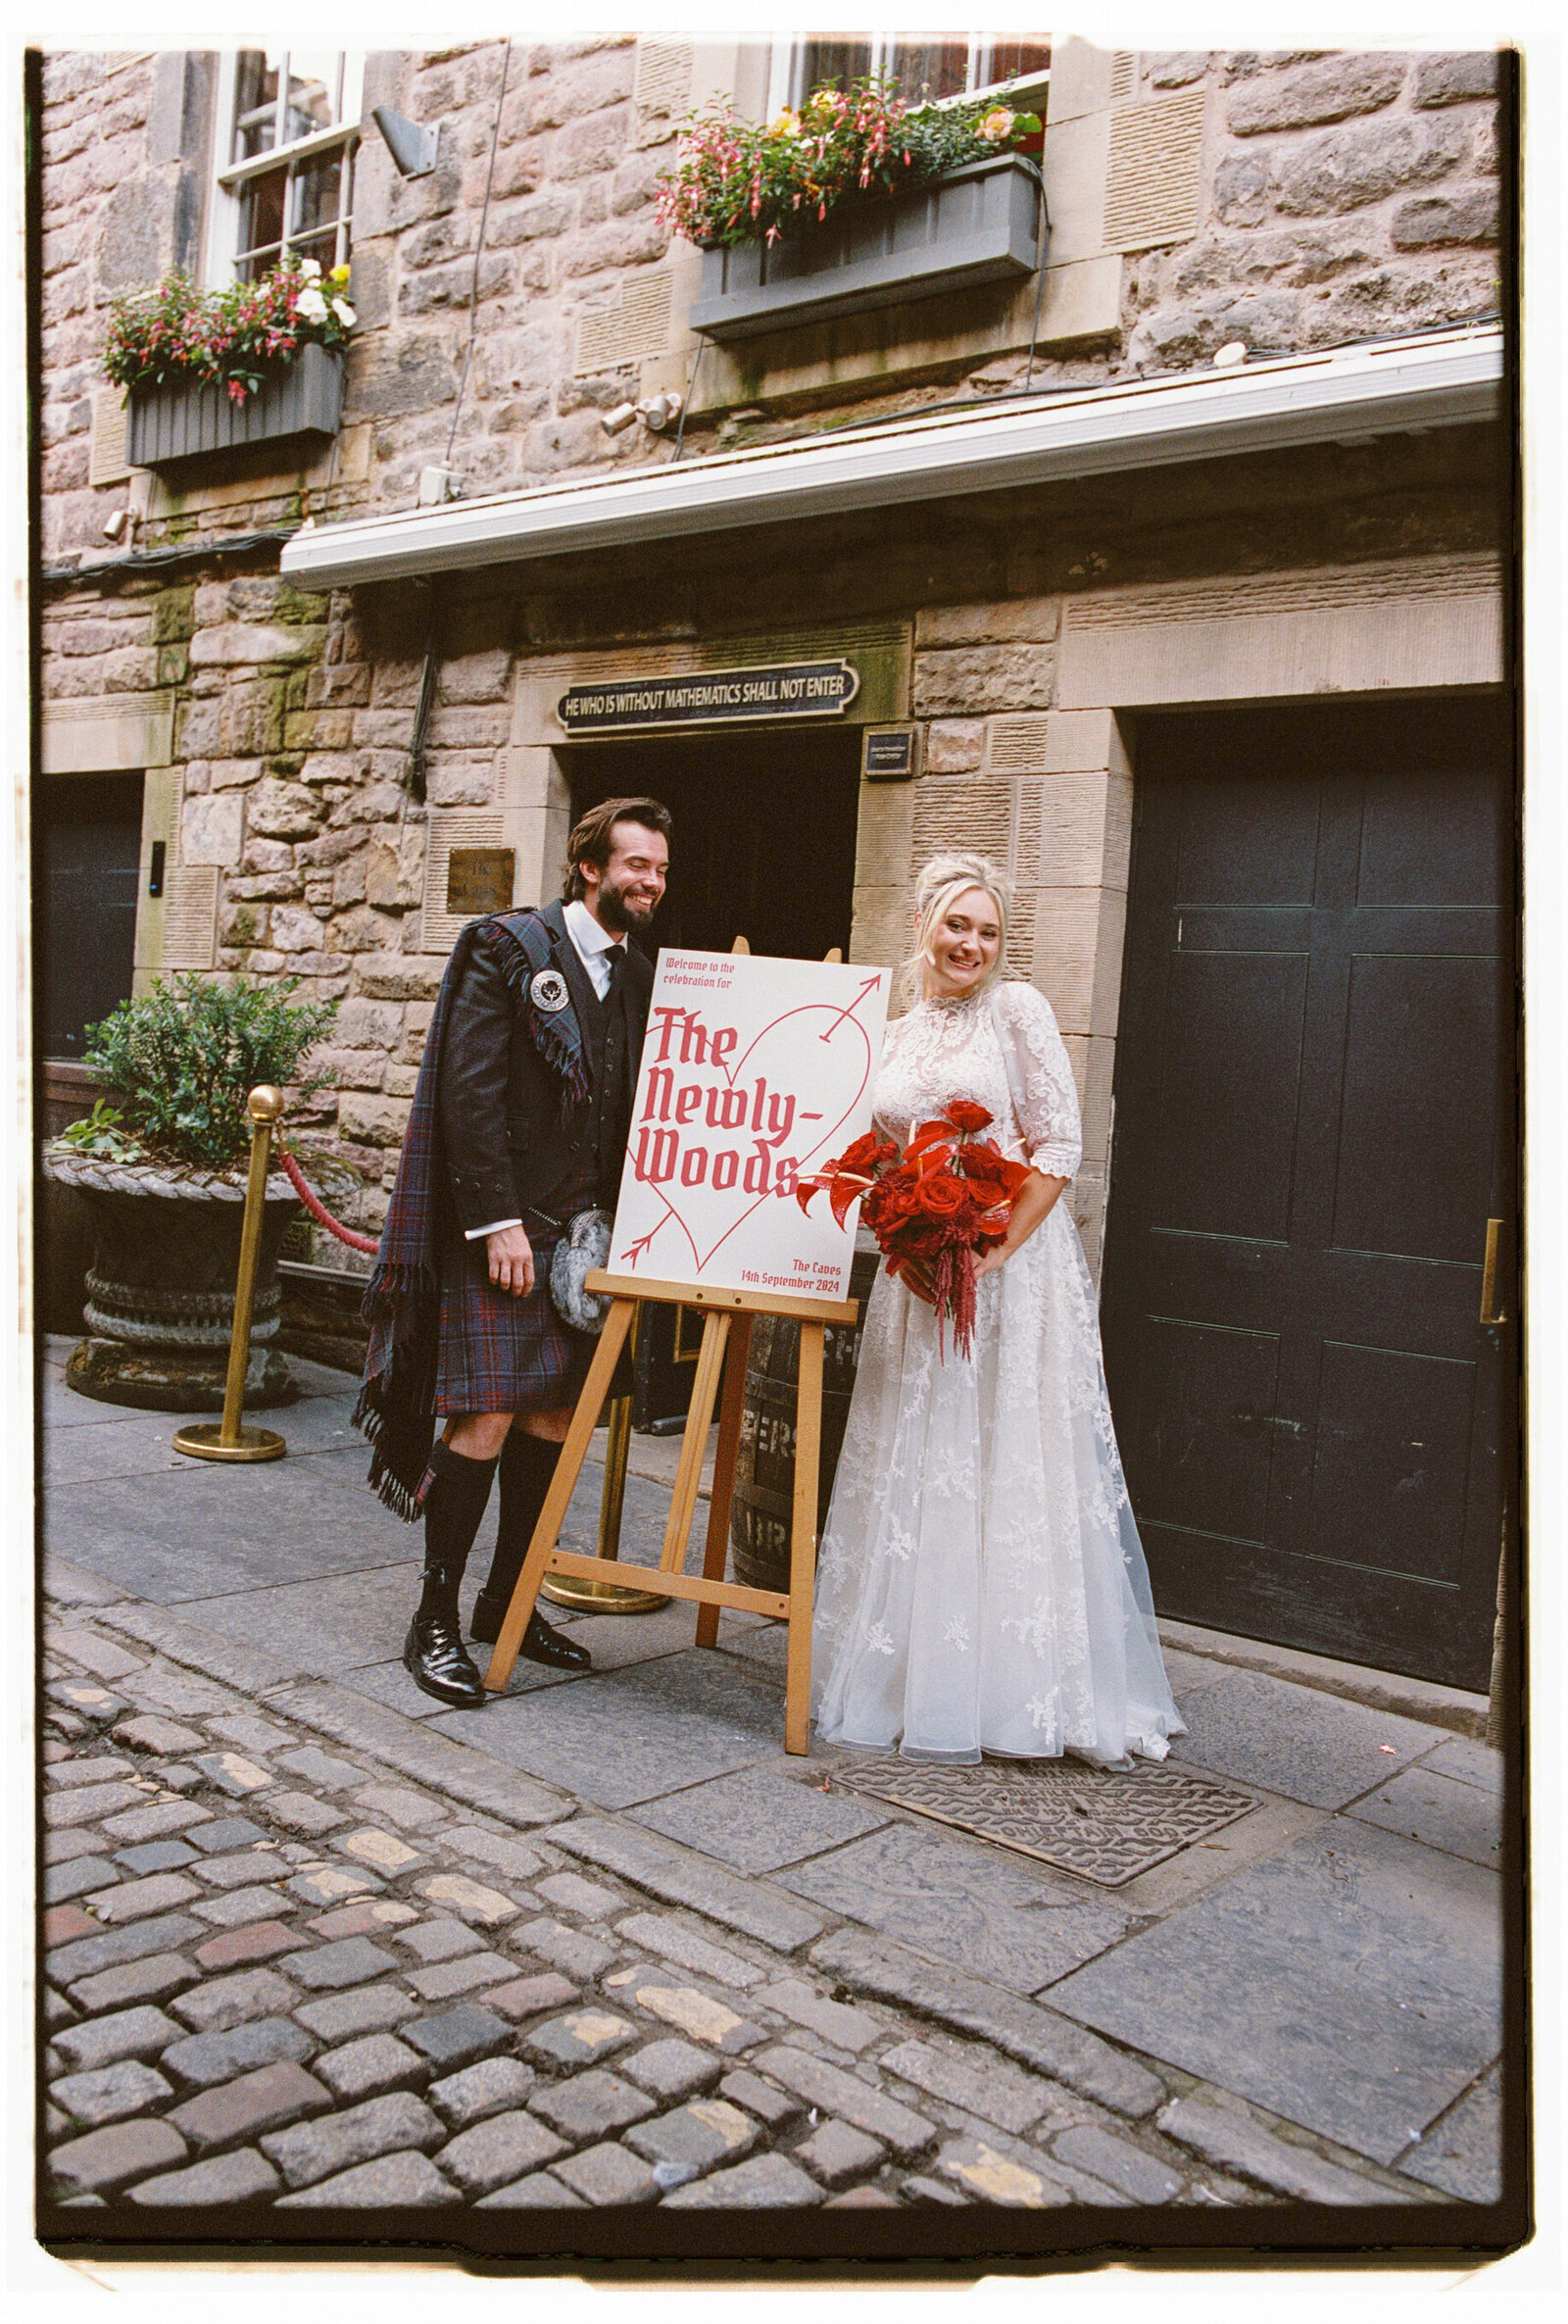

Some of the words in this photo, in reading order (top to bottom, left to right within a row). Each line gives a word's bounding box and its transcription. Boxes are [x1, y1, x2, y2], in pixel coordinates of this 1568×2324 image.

[565, 698, 579, 717] HE
[579, 695, 605, 716] WHO
[605, 693, 615, 714] IS
[615, 690, 664, 714] WITHOUT
[665, 684, 741, 710] MATHEMATICS
[742, 680, 779, 703] SHALL
[779, 677, 806, 700] NOT
[807, 674, 844, 698] ENTER
[665, 957, 708, 971] Welcome
[710, 963, 718, 972] to
[720, 963, 735, 973] the
[663, 973, 715, 988] celebration
[716, 977, 732, 989] for
[654, 1007, 738, 1067] The
[639, 1066, 824, 1148] Newly-
[635, 1126, 800, 1199] Woods
[793, 1260, 810, 1272] The
[812, 1262, 842, 1276] Caves
[742, 1269, 760, 1283] 14th
[761, 1272, 814, 1290] September
[815, 1279, 840, 1293] 2024
[1001, 1826, 1124, 1839] CHIEFTAIN
